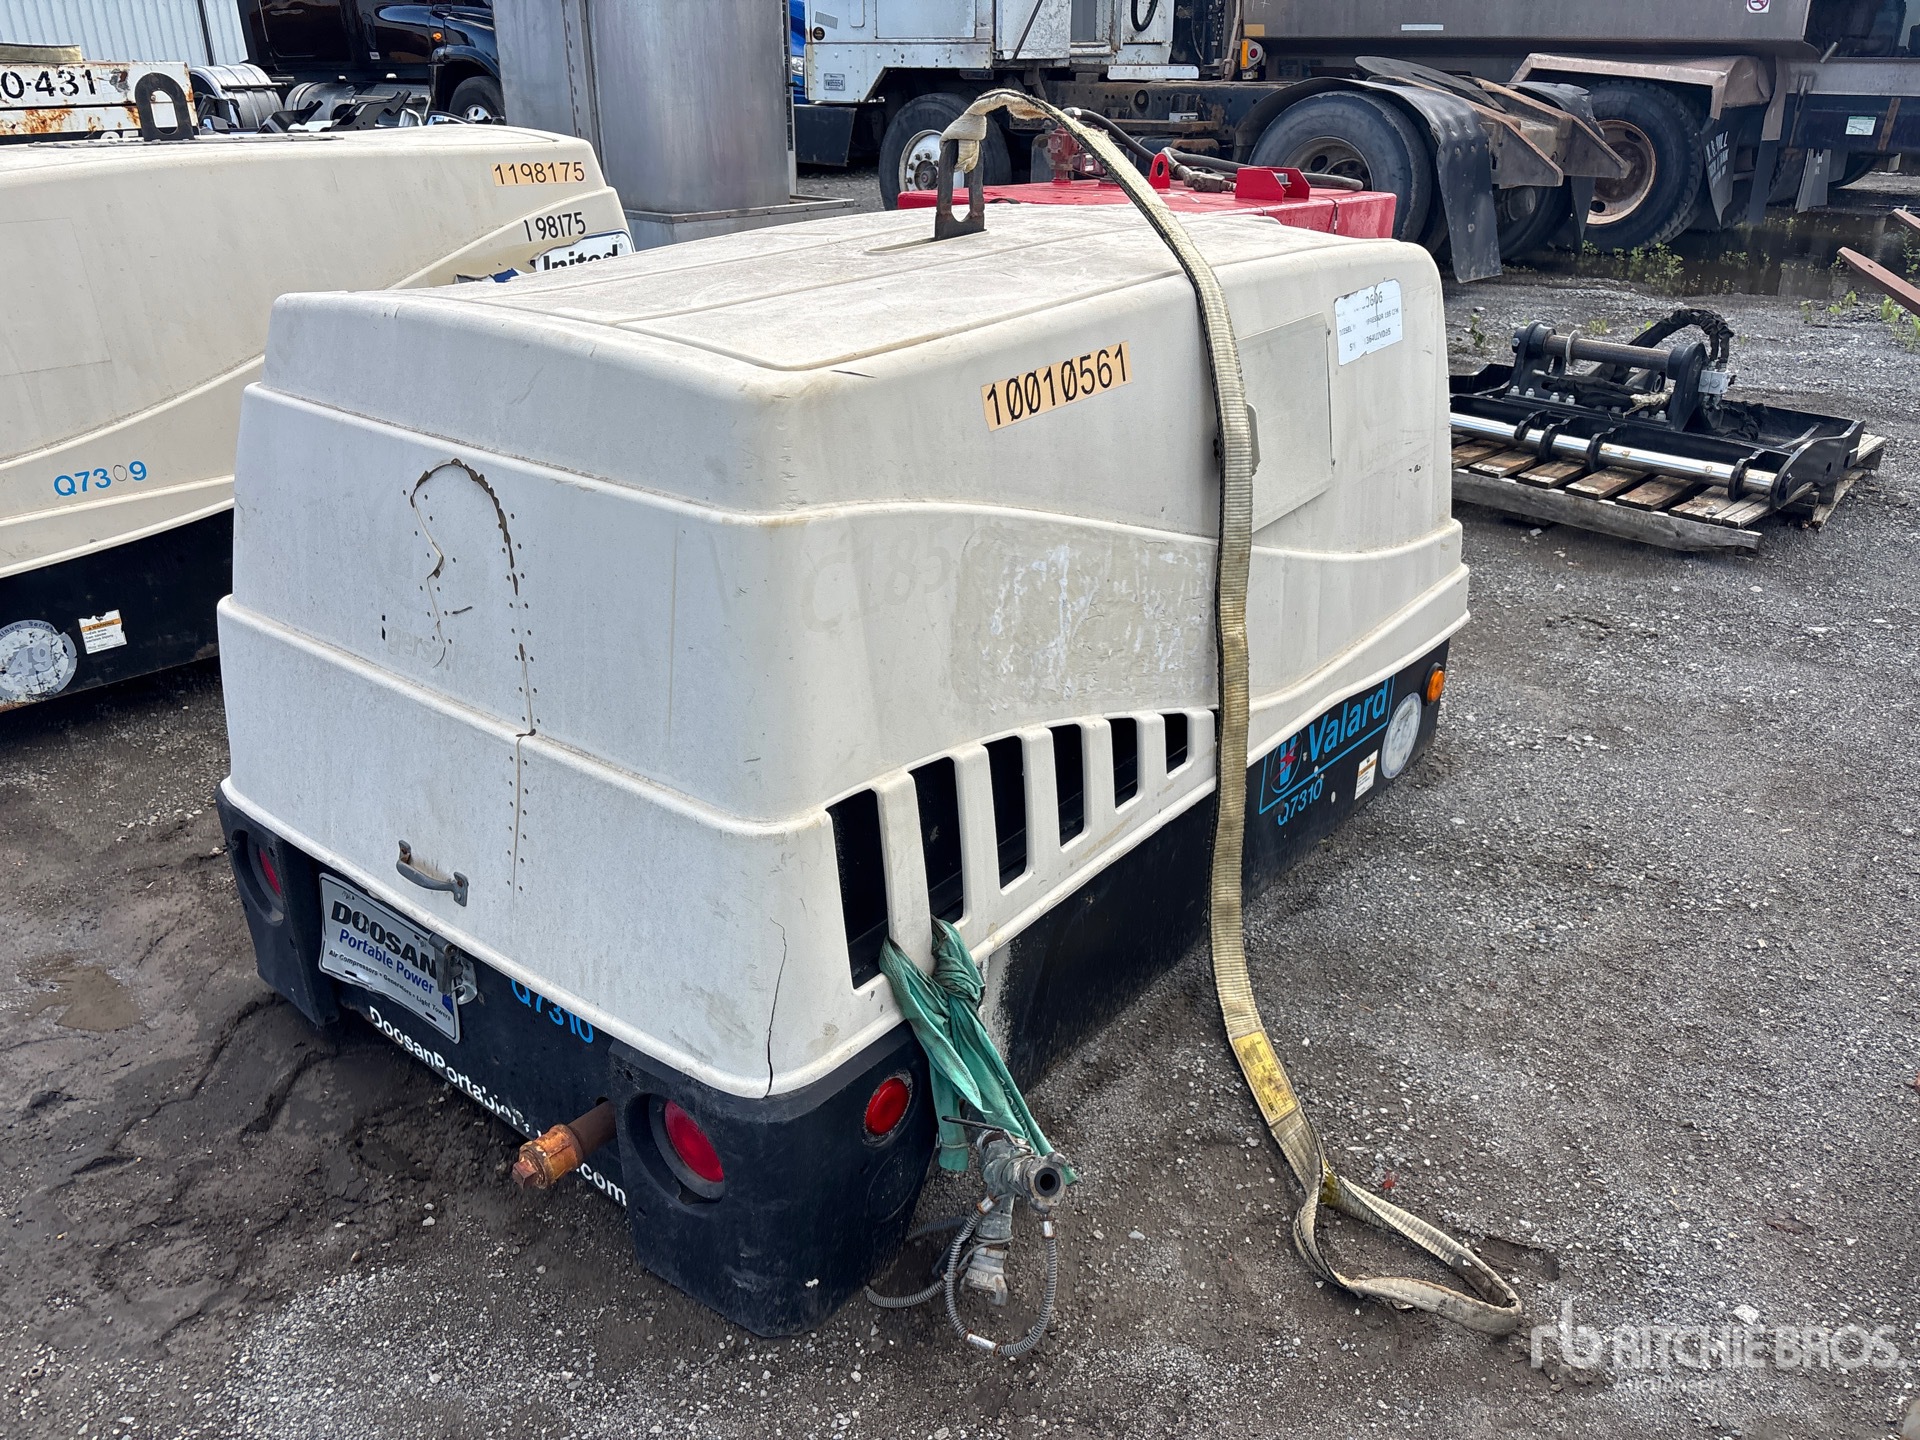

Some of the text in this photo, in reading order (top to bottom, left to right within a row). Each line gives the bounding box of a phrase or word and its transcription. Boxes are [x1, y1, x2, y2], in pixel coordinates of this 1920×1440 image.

[494, 161, 585, 185] 1198175
[986, 343, 1127, 426] 10010561
[53, 460, 148, 497] Q7309
[1308, 680, 1389, 763] Valard
[330, 900, 438, 980] DOOSAN
[338, 928, 435, 996] Portable Power
[328, 949, 338, 960] Air
[338, 953, 379, 977] Compressors
[383, 974, 413, 997] Generators
[416, 995, 431, 1010] Light
